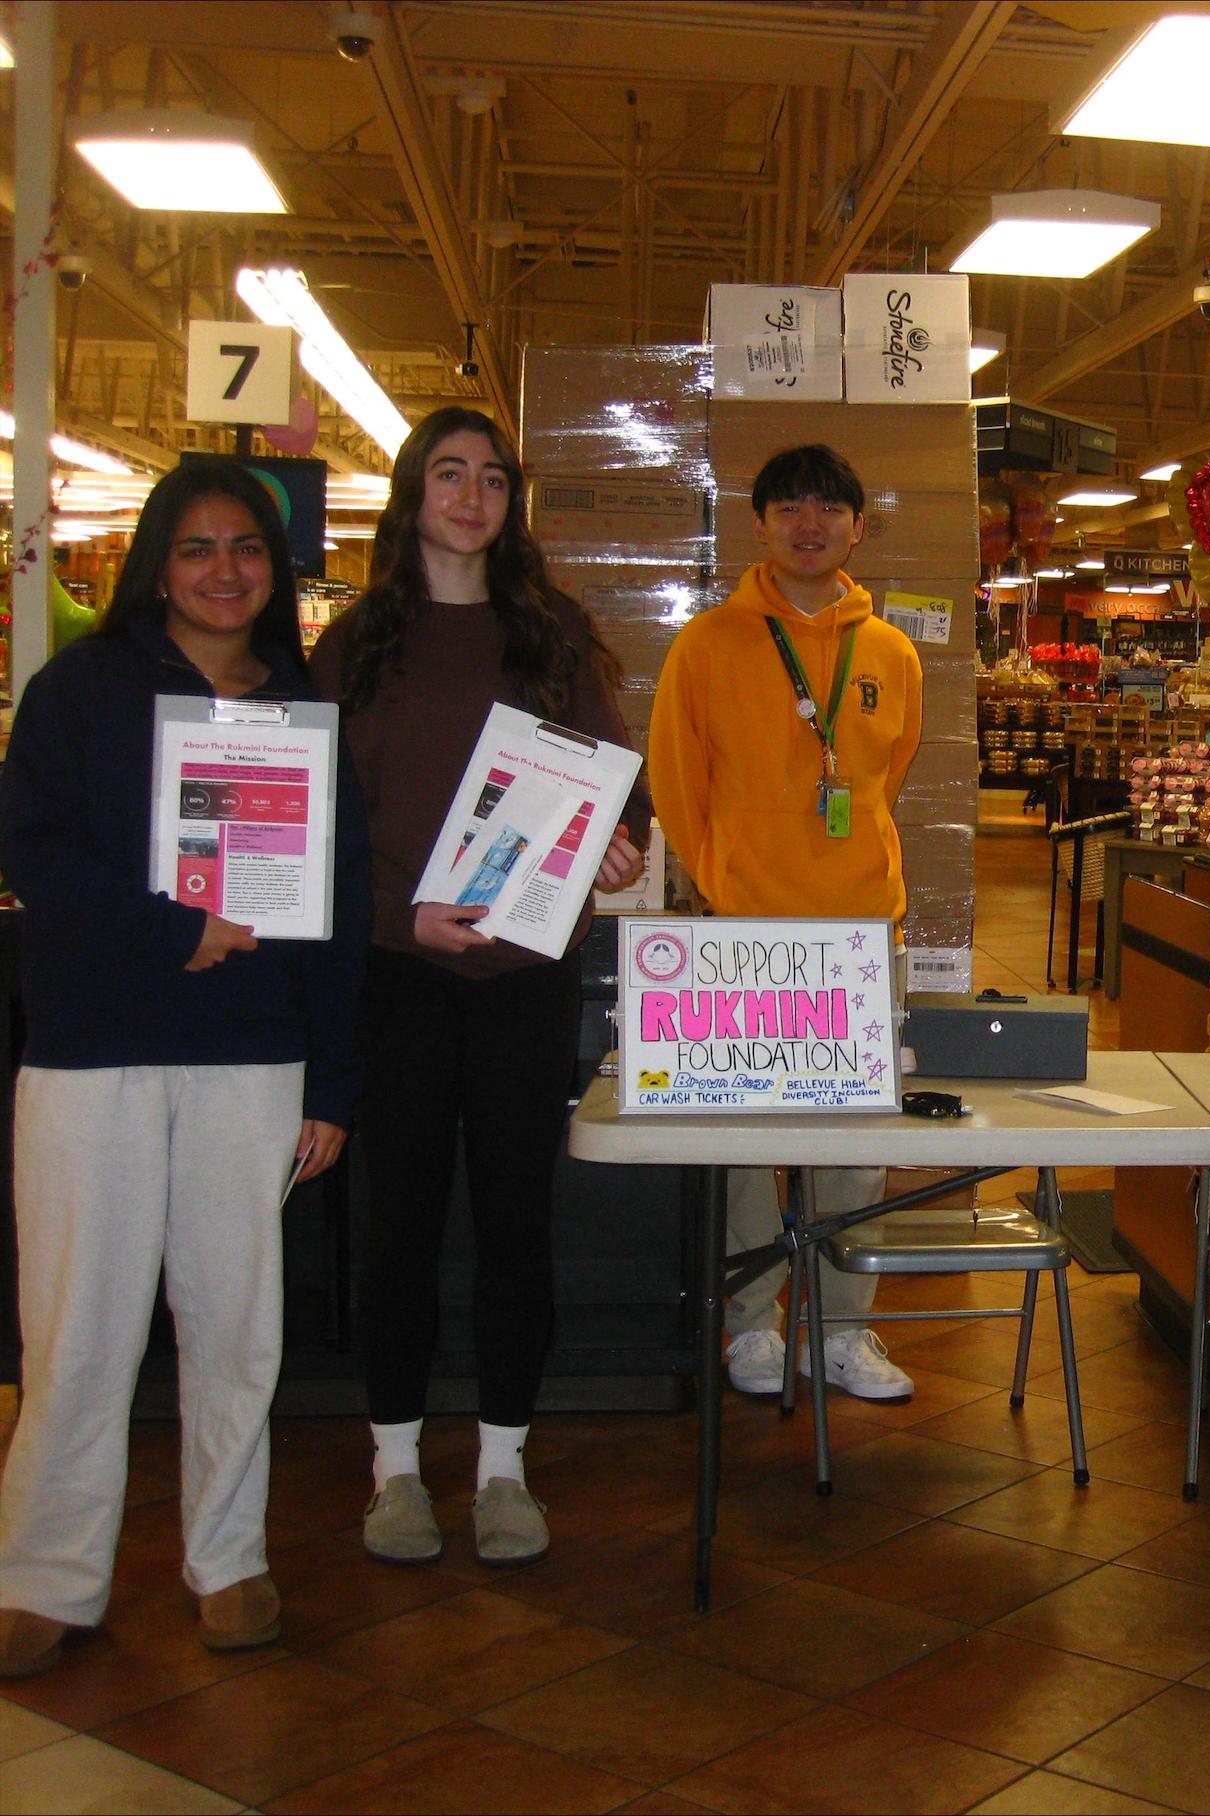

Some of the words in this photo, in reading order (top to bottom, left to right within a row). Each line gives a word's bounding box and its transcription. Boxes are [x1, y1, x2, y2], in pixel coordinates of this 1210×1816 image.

[882, 289, 922, 390] Stonefire
[220, 344, 260, 400] 7
[1128, 557, 1190, 571] KITCHEN
[860, 681, 878, 708] B
[182, 740, 208, 750] About
[210, 741, 225, 751] The
[227, 743, 261, 753] Rukmini
[263, 744, 310, 754] Foundation
[239, 755, 266, 763] Mission
[498, 750, 519, 764] About
[520, 756, 532, 767] The
[533, 761, 562, 778] Rukmini
[563, 772, 601, 792] Foundation
[697, 940, 835, 986] SUPPORT
[640, 988, 849, 1042] RUKMINI
[677, 1040, 858, 1072] FOUNDATION
[673, 1072, 728, 1089] Brown
[731, 1073, 775, 1090] Bear
[786, 1079, 837, 1090] BELLEVUE
[841, 1079, 866, 1090] HIGH
[639, 1093, 661, 1105] CAR
[661, 1093, 691, 1104] WASH
[696, 1092, 738, 1104] TICKETS
[782, 1090, 829, 1100] DIVERSITY
[831, 1089, 880, 1098] INCLUSION
